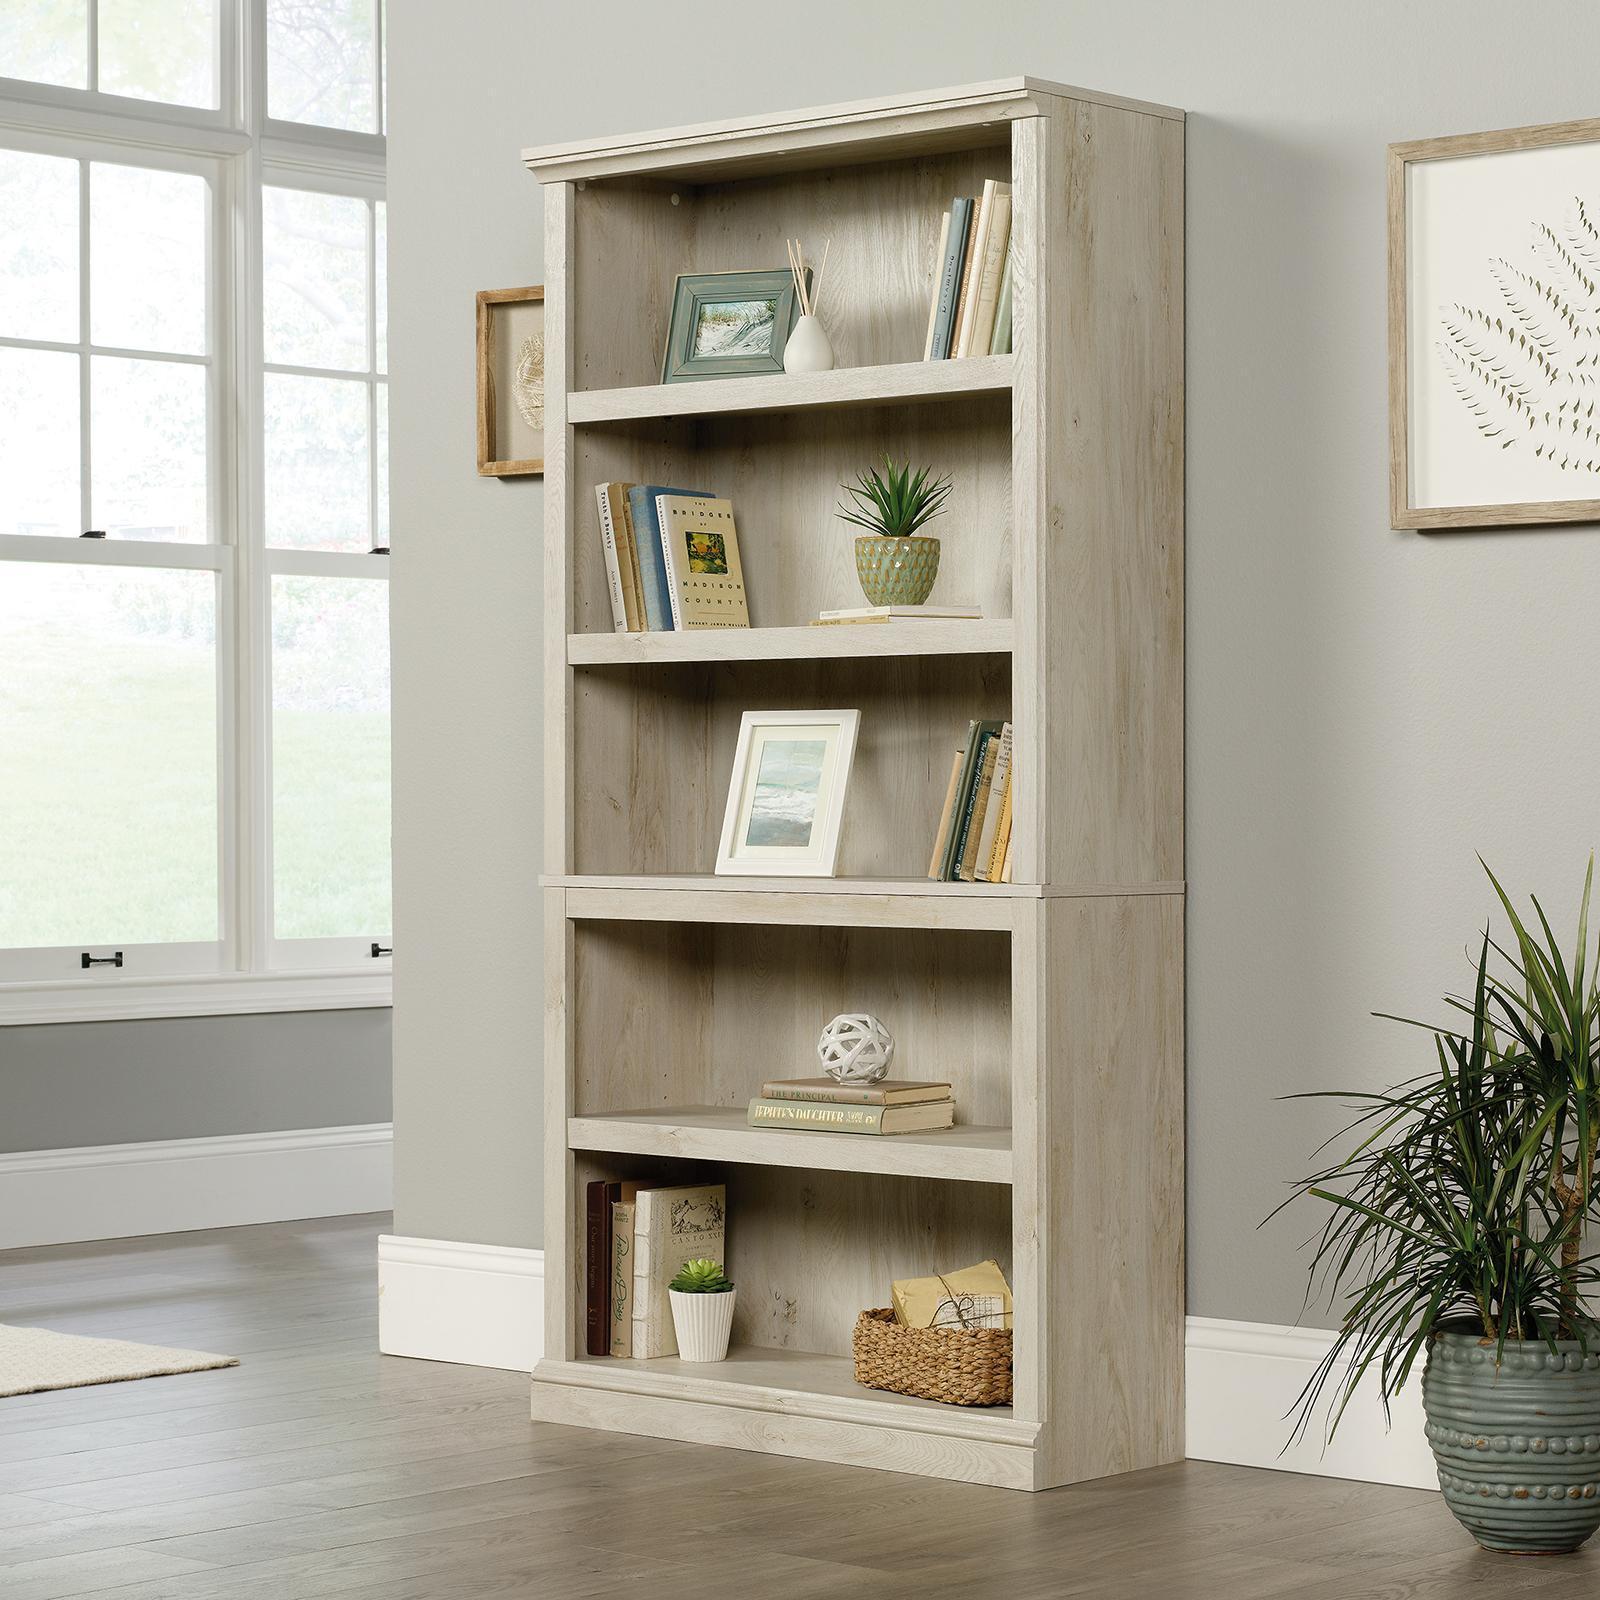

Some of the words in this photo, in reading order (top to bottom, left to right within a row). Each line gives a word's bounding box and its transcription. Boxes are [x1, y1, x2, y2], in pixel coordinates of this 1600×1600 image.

[673, 510, 730, 518] BRIDGES
[971, 774, 980, 795] Madison
[966, 795, 975, 814] County
[791, 1090, 837, 1101] PRINCIPAL
[796, 1108, 844, 1123] DAUGHTER
[672, 1234, 704, 1245] CANTO
[614, 1277, 628, 1322] Daisy
